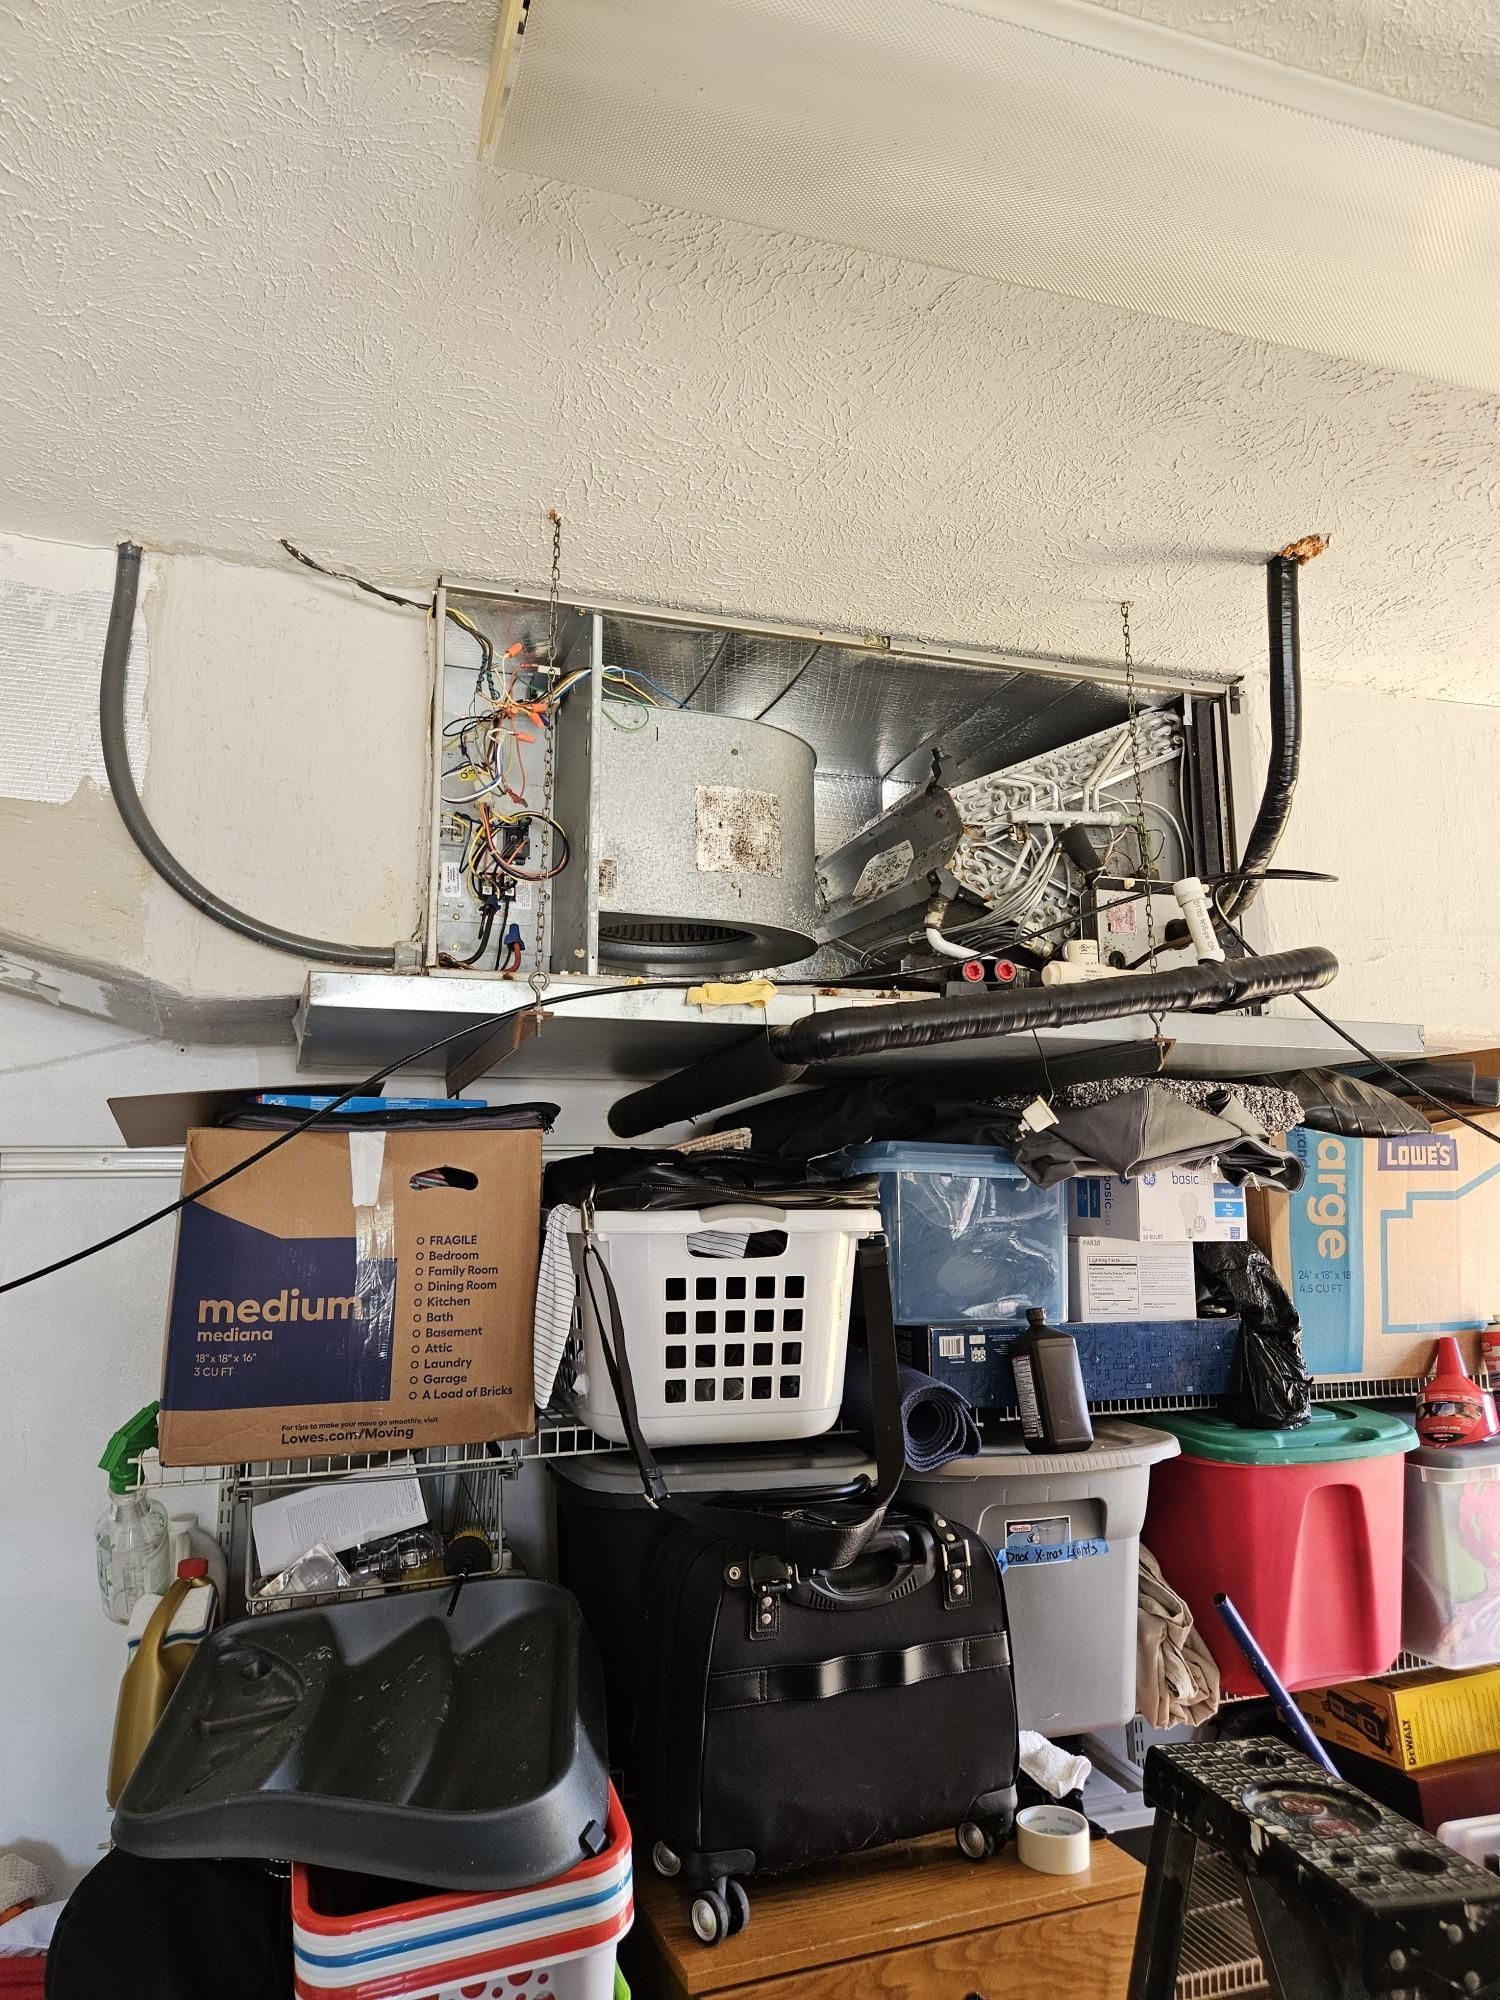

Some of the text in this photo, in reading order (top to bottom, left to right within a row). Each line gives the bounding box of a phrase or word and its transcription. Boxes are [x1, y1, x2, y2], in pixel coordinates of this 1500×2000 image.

[1294, 1126, 1311, 1168] grand
[1386, 1141, 1451, 1166] LOWE'S
[1171, 1170, 1200, 1185] basic
[1306, 1137, 1347, 1260] arge
[429, 1235, 478, 1245] FRAGILE
[429, 1251, 479, 1260] Bedroom
[428, 1265, 498, 1277] Family Room
[427, 1281, 497, 1293] Dining Room
[1299, 1284, 1343, 1294] 4.5 CU FT
[198, 1287, 364, 1324] medium
[427, 1297, 471, 1307] Kitchen
[426, 1312, 454, 1322] Bath
[197, 1327, 273, 1342] mediana
[425, 1326, 483, 1338] Basement
[424, 1343, 453, 1354] Attic
[195, 1353, 210, 1363] 18"
[218, 1353, 233, 1363] 18"
[242, 1352, 257, 1363] 16"
[424, 1358, 473, 1369] Laundry
[193, 1367, 234, 1377] 3 CU FT
[423, 1374, 468, 1385] Garage
[422, 1385, 513, 1400] A Load of Bricks
[281, 1424, 293, 1432] For
[294, 1424, 309, 1432] tips
[318, 1422, 339, 1430] make
[340, 1421, 357, 1429] your
[388, 1417, 423, 1425] smoothly,
[424, 1416, 439, 1424] visit
[281, 1427, 415, 1445] Lowes.com/Moving
